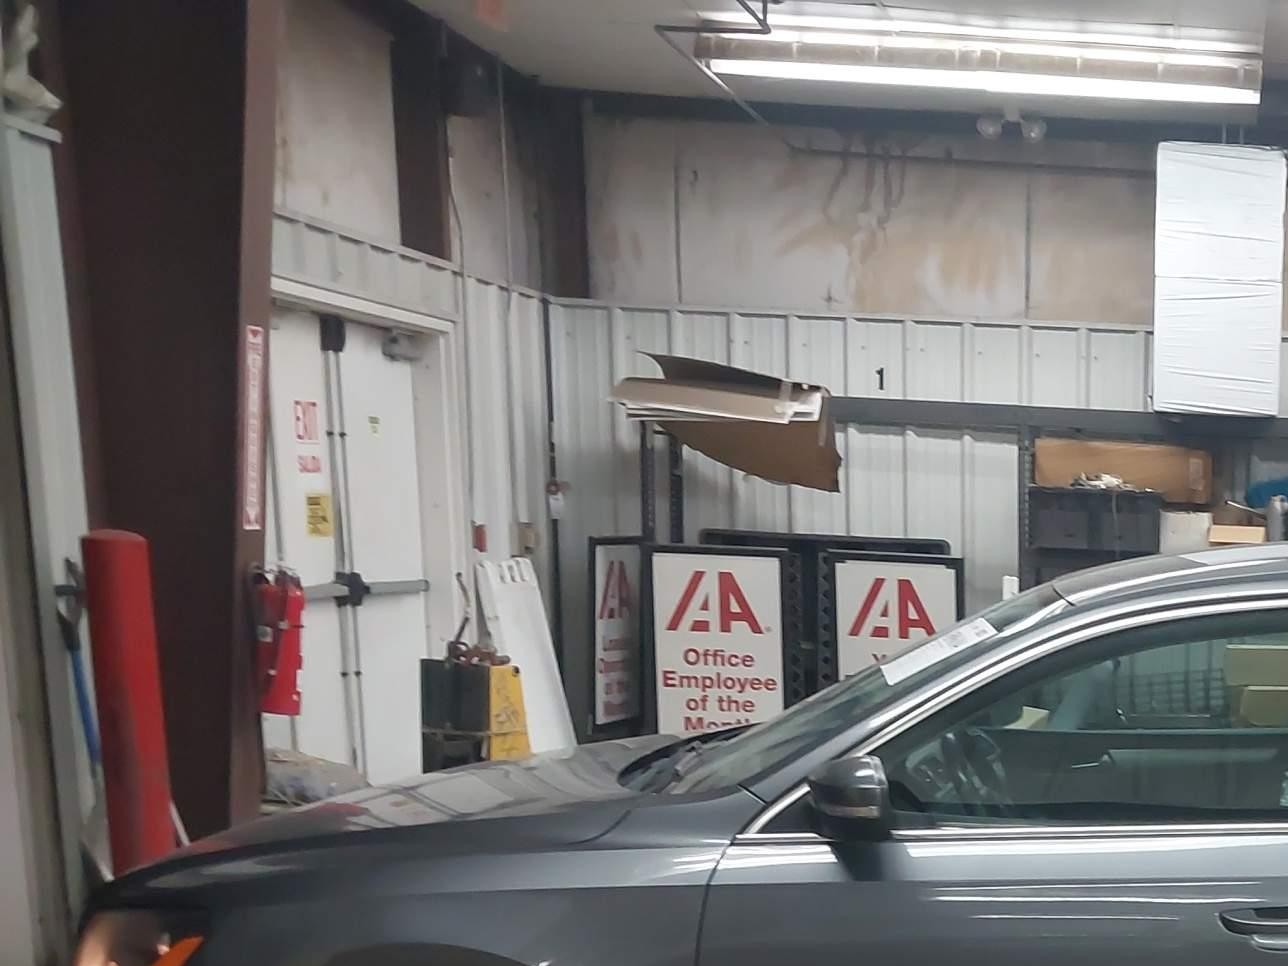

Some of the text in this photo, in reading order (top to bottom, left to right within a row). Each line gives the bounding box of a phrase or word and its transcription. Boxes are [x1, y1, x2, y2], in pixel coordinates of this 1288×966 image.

[875, 367, 885, 391] 1
[684, 648, 755, 668] Office
[662, 670, 777, 693] Employee
[686, 695, 755, 713] of the
